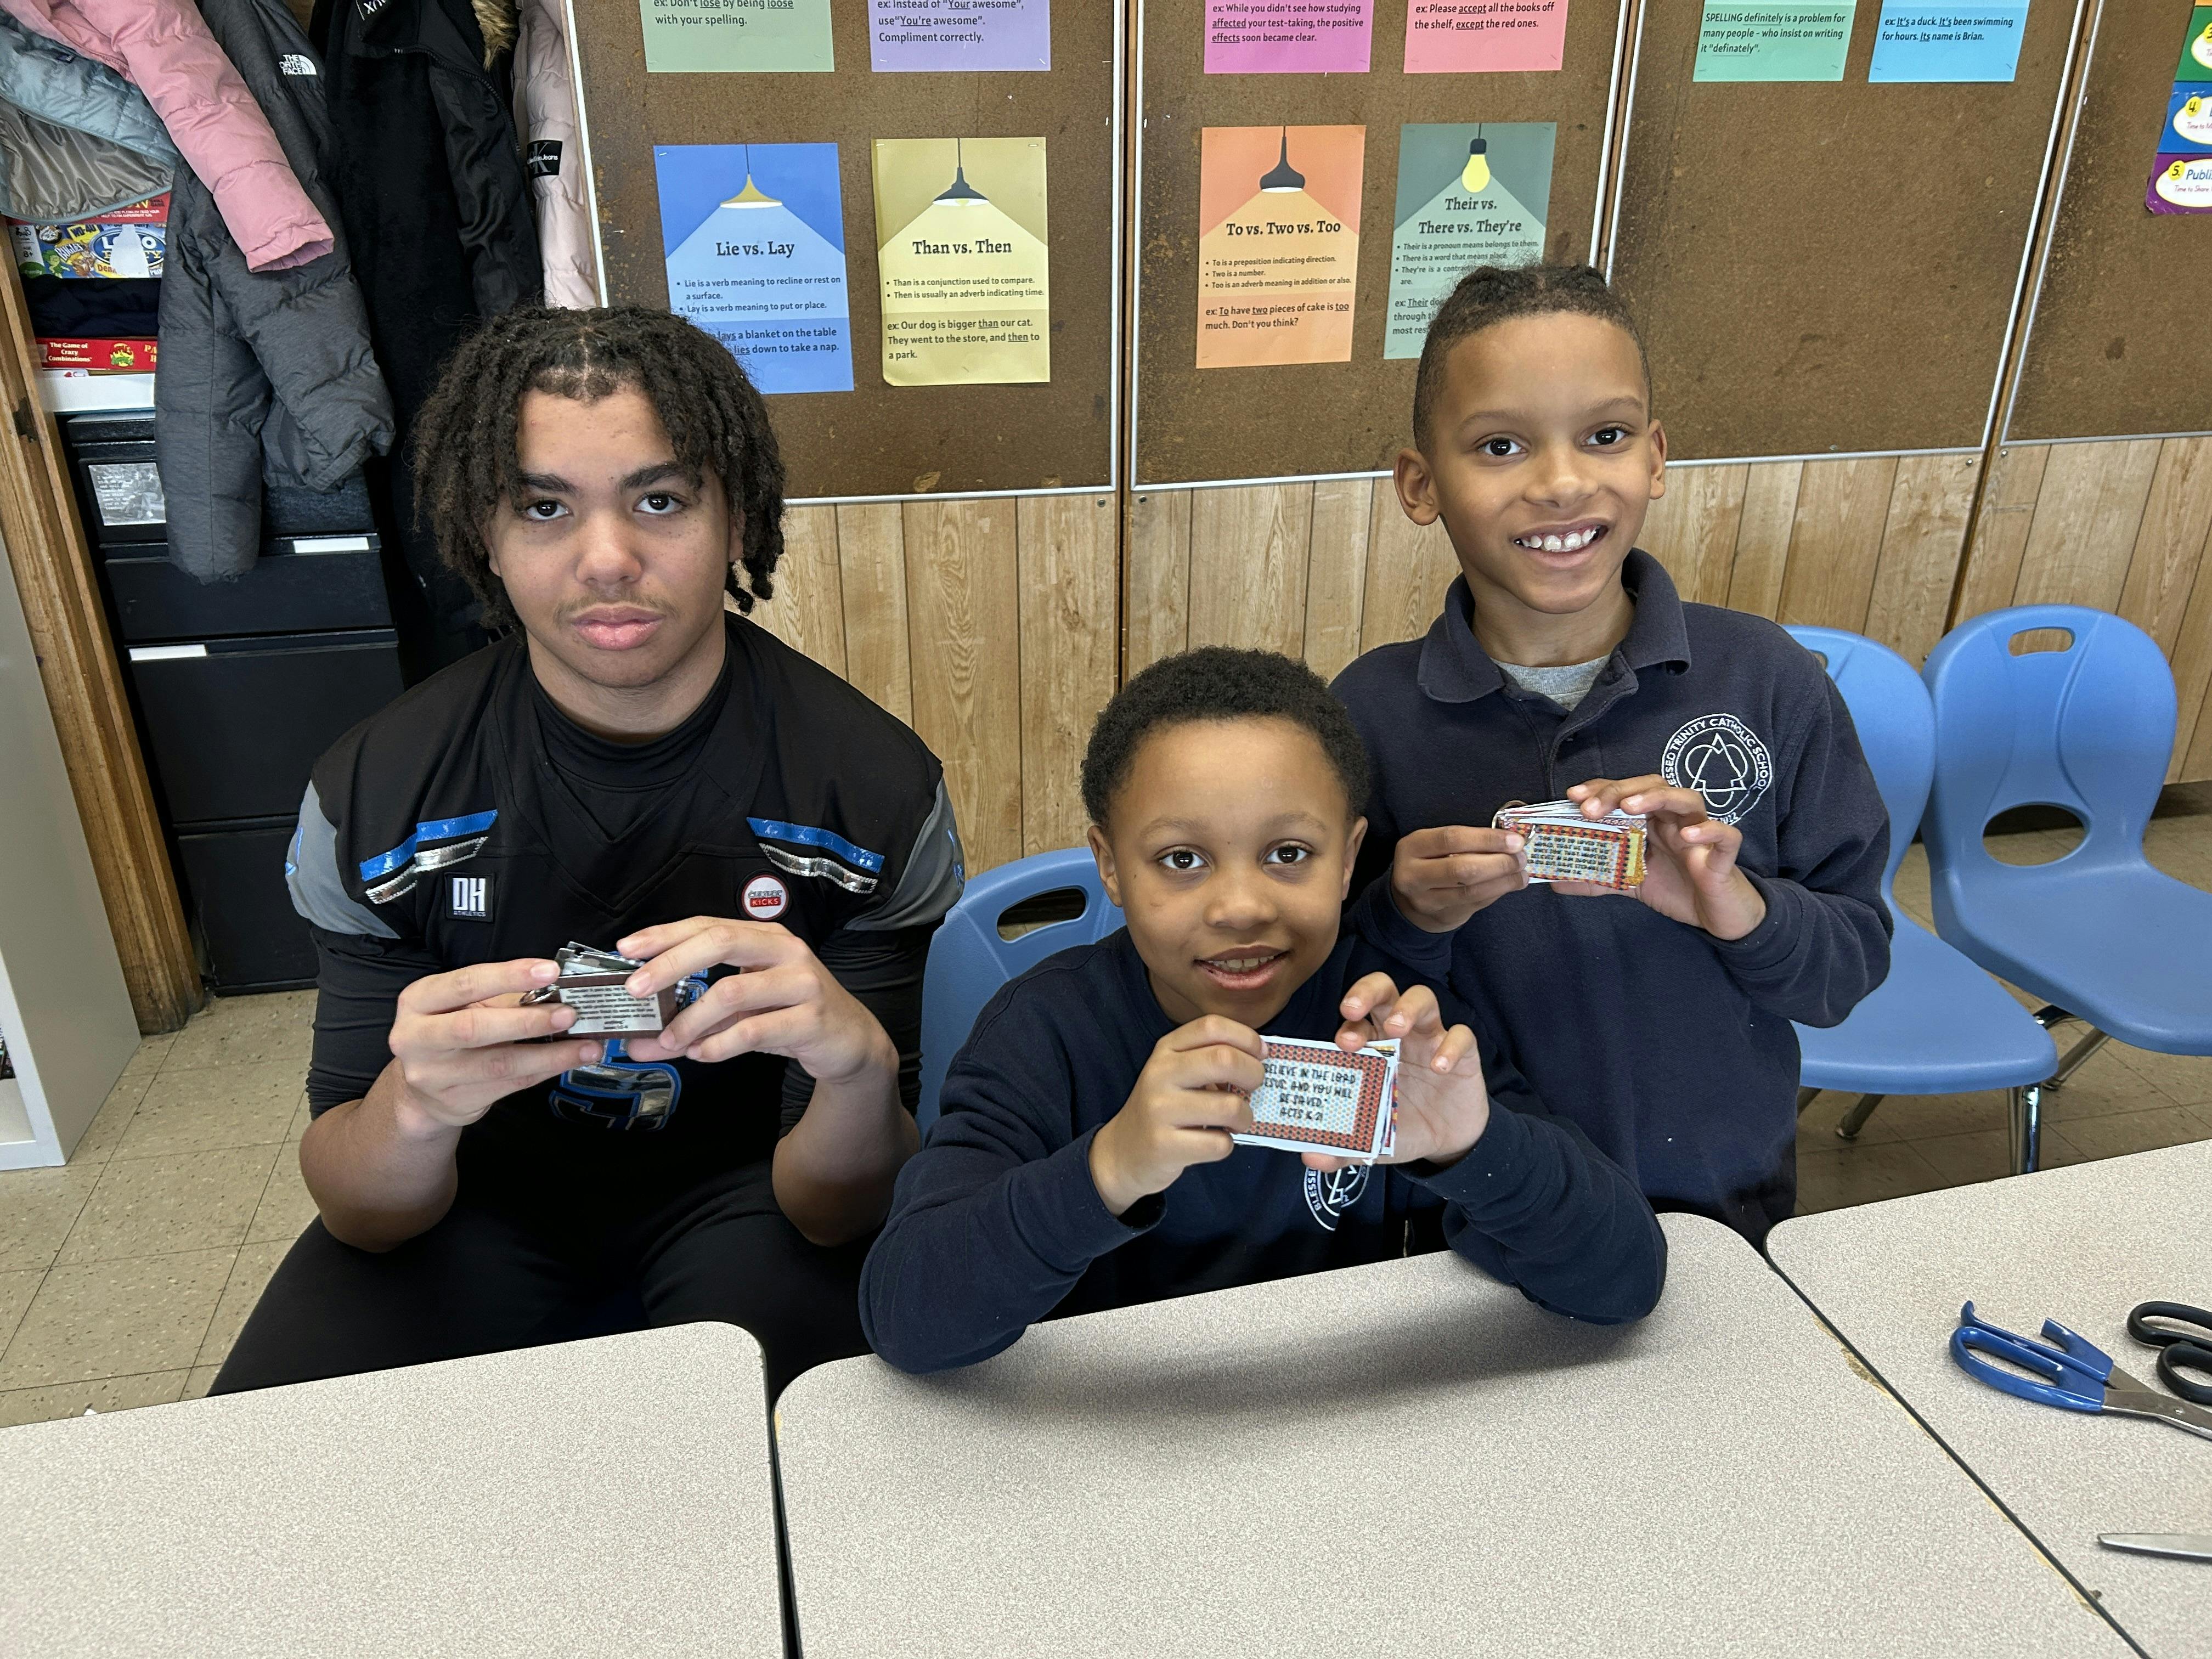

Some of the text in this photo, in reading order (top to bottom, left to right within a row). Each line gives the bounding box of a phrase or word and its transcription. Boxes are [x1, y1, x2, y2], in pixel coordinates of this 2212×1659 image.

[699, 0, 721, 9] lose
[723, 0, 734, 9] by
[737, 0, 764, 9] being
[767, 0, 794, 9] loose
[893, 0, 928, 8] Instead
[1226, 3, 1248, 12] While
[1267, 3, 1291, 12] didn't
[1308, 3, 1325, 12] how
[1327, 3, 1361, 14] studying
[1430, 3, 1457, 13] Please
[1459, 4, 1486, 15] accept
[1488, 2, 1498, 12] all
[1500, 2, 1514, 12] the
[1516, 2, 1540, 12] books
[1542, 1, 1555, 11] off
[655, 14, 747, 26] with your spelling.
[1212, 18, 1363, 29] affected your test-taking, the positive
[1415, 19, 1429, 29] the
[1431, 19, 1453, 30] shelf,
[1456, 20, 1484, 30] except
[1486, 18, 1499, 27] the
[1502, 18, 1515, 27] red
[1706, 13, 1742, 22] SPELLING
[1744, 12, 1784, 23] definitely
[1785, 13, 1791, 22] is
[1798, 13, 1831, 24] problem
[1833, 13, 1846, 22] for
[1897, 17, 1909, 27] It's
[1938, 17, 1951, 27] It's
[1953, 16, 1972, 25] been
[1973, 17, 2013, 27] swimming
[879, 31, 983, 44] Compliment correctly.
[1212, 32, 1240, 43] effects
[1263, 32, 1294, 41] became
[1295, 32, 1316, 41] clear.
[1882, 31, 1894, 40] for
[1894, 31, 1918, 40] hours.
[1920, 32, 1930, 42] Its
[1955, 31, 1961, 40] is
[1962, 32, 1984, 40] Brian.
[1701, 44, 1707, 52] it
[2189, 101, 2197, 112] 4.
[2172, 165, 2180, 176] 5.
[1444, 196, 1496, 210] Their vs.
[1226, 220, 1340, 235] To vs. Two vs. Too
[1418, 218, 1521, 235] There vs. They're
[715, 241, 794, 259] Lie vs. Lay
[912, 238, 1011, 254] Than vs. Then
[1218, 307, 1229, 317] To
[1231, 306, 1250, 314] have
[1251, 306, 1267, 315] two
[1269, 304, 1295, 315] pieces
[1297, 303, 1305, 312] of
[1307, 302, 1325, 311] cake
[1335, 303, 1348, 311] too
[745, 329, 780, 338] blanket
[795, 328, 811, 337] the
[813, 327, 836, 336] table
[887, 335, 909, 346] They
[946, 334, 961, 342] the
[963, 335, 988, 343] store,
[990, 332, 1006, 341] and
[1008, 332, 1029, 342] then
[1672, 720, 1705, 751] TRINITY
[1709, 718, 1756, 747] CATHOLIC
[453, 877, 486, 911] DH
